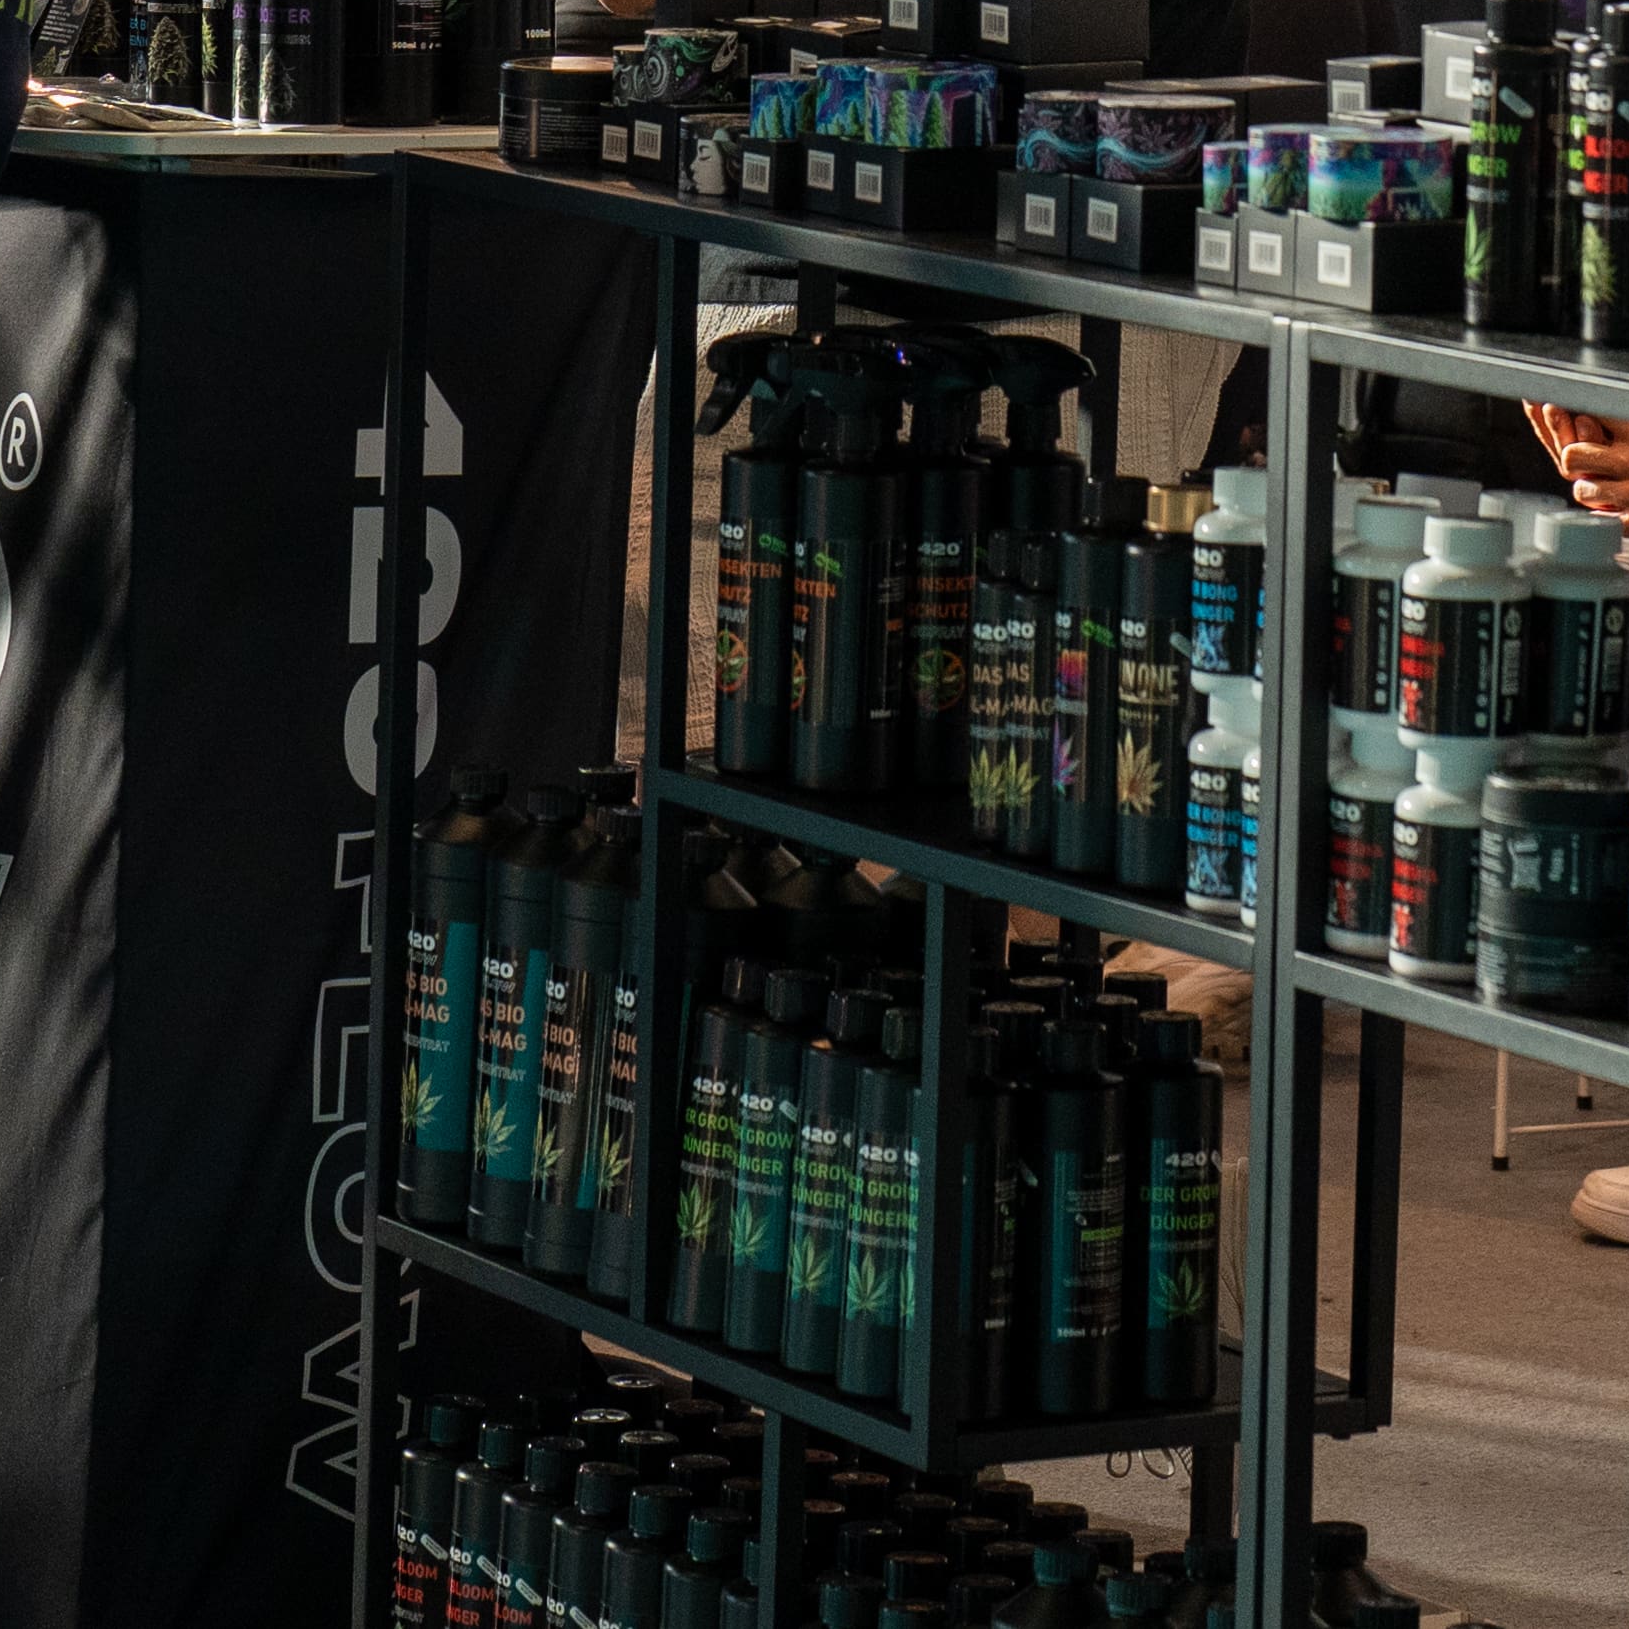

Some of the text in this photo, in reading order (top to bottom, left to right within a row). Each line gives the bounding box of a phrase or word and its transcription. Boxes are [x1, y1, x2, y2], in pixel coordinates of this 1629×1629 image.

[418, 973, 448, 997] BIO
[494, 1002, 526, 1026] BIO
[549, 1023, 575, 1047] BIO
[692, 1075, 727, 1097] 420
[739, 1092, 775, 1113] 420
[746, 1127, 795, 1150] GROW
[801, 1124, 838, 1146] 420
[858, 1143, 899, 1163] 420
[1164, 1150, 1209, 1168] 420
